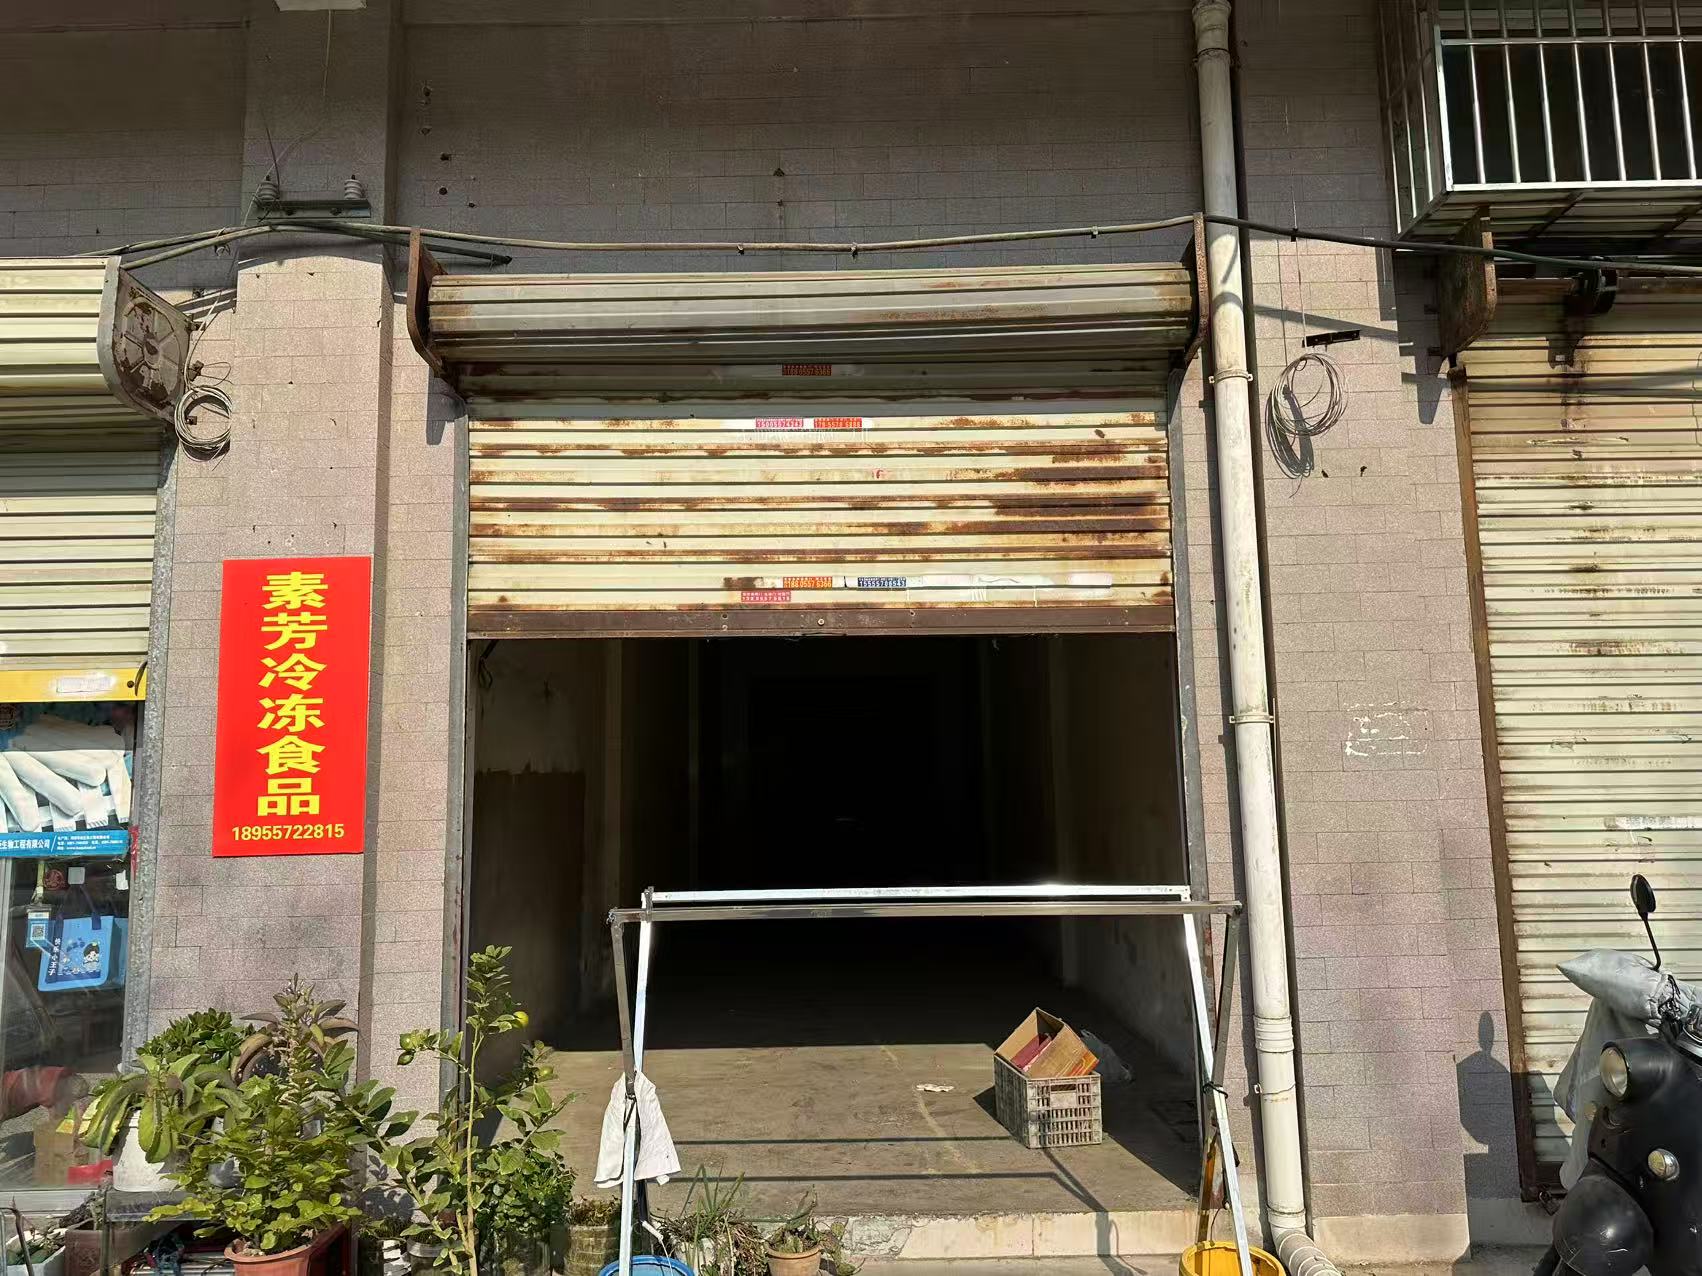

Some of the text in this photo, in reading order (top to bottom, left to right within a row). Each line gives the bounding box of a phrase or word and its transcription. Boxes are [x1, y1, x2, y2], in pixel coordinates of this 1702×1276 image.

[257, 571, 328, 817] 素芳冷冻食品
[231, 823, 345, 841] 18955722815
